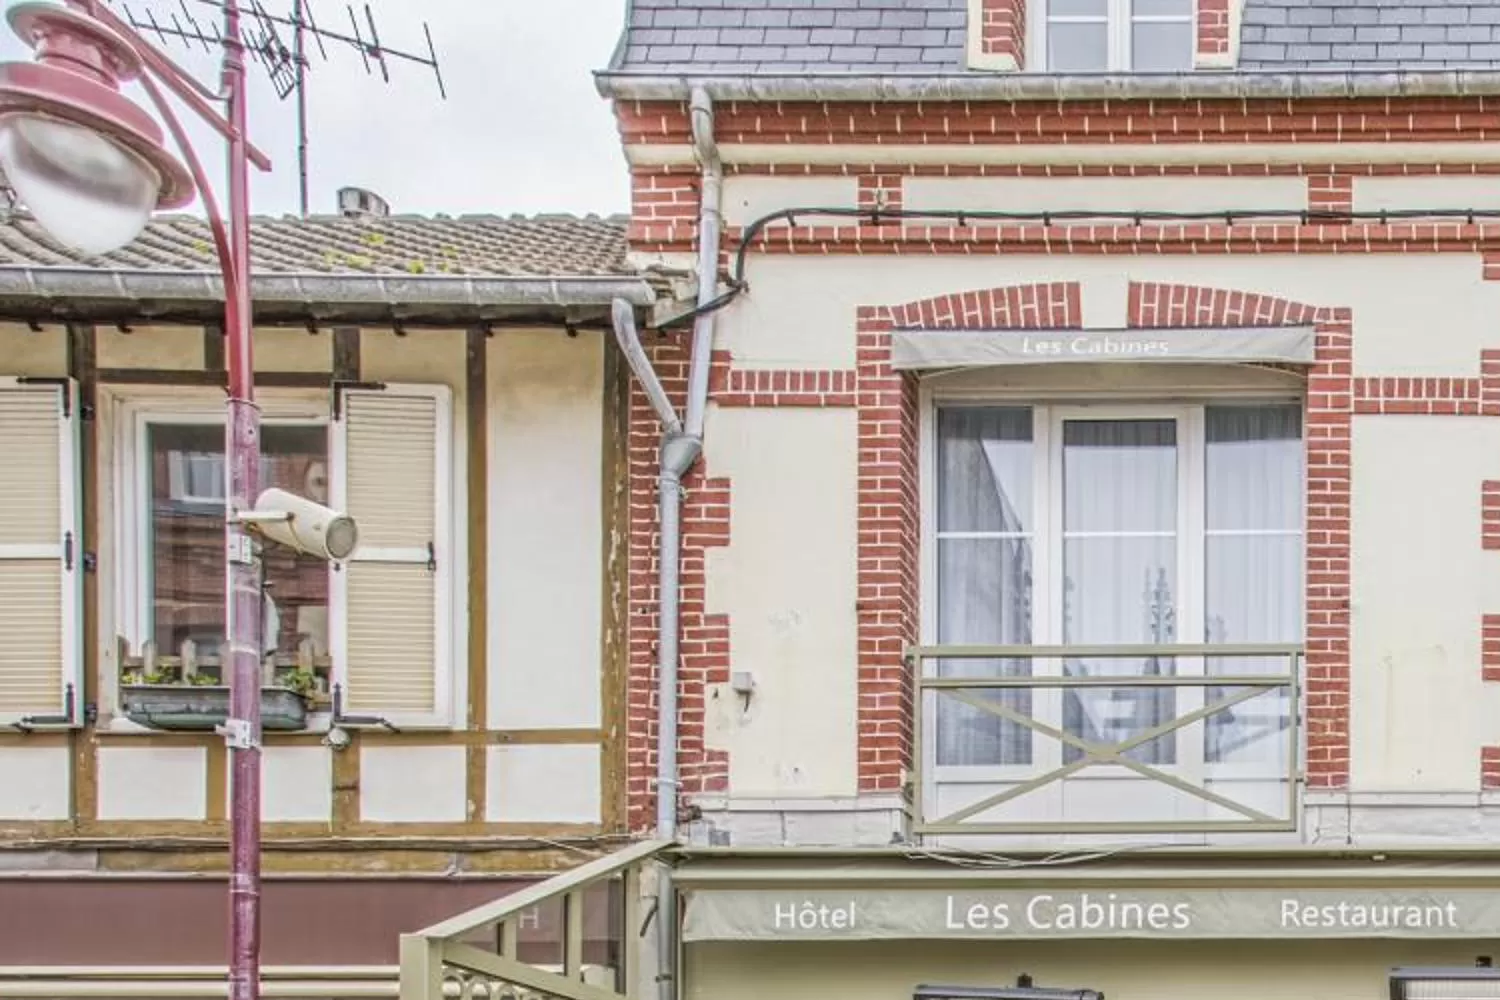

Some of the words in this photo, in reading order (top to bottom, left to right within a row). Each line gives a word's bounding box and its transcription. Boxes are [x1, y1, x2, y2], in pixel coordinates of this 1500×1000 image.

[1021, 335, 1063, 355] Les
[1070, 335, 1170, 356] Cabines
[775, 899, 857, 930] Hôtel
[946, 894, 1011, 931] Les
[1026, 893, 1191, 930] Cabines
[1281, 899, 1457, 929] Restaurant
